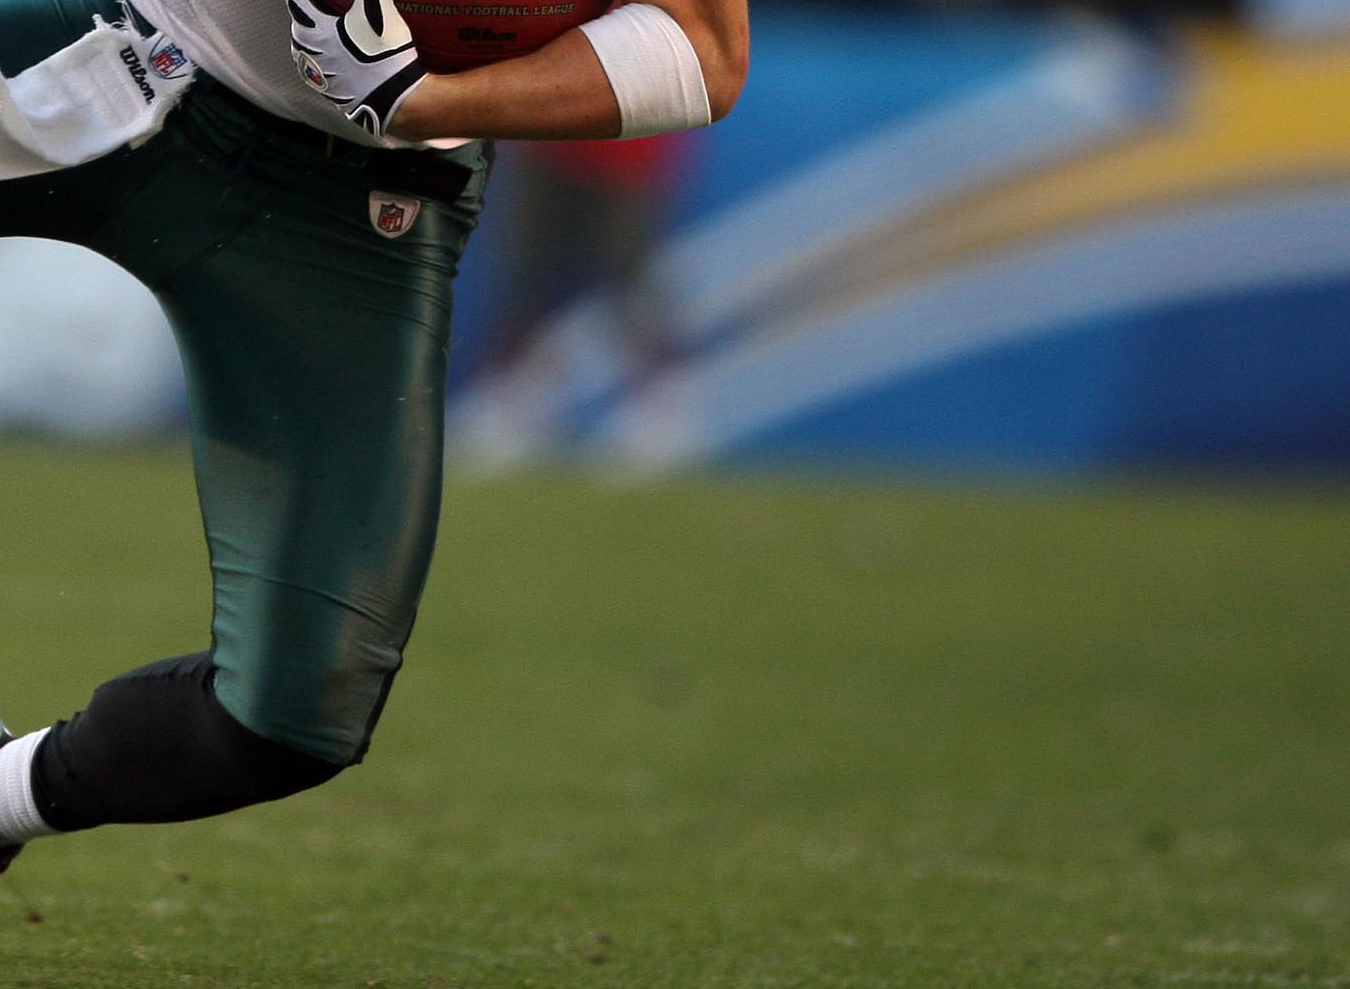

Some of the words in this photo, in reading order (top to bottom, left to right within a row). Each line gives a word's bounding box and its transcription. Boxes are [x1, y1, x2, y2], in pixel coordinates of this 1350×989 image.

[396, 0, 459, 16] NATIONAL
[465, 3, 529, 17] FOOTBALL
[534, 2, 575, 17] LEAGUE
[119, 44, 155, 106] Wilson
